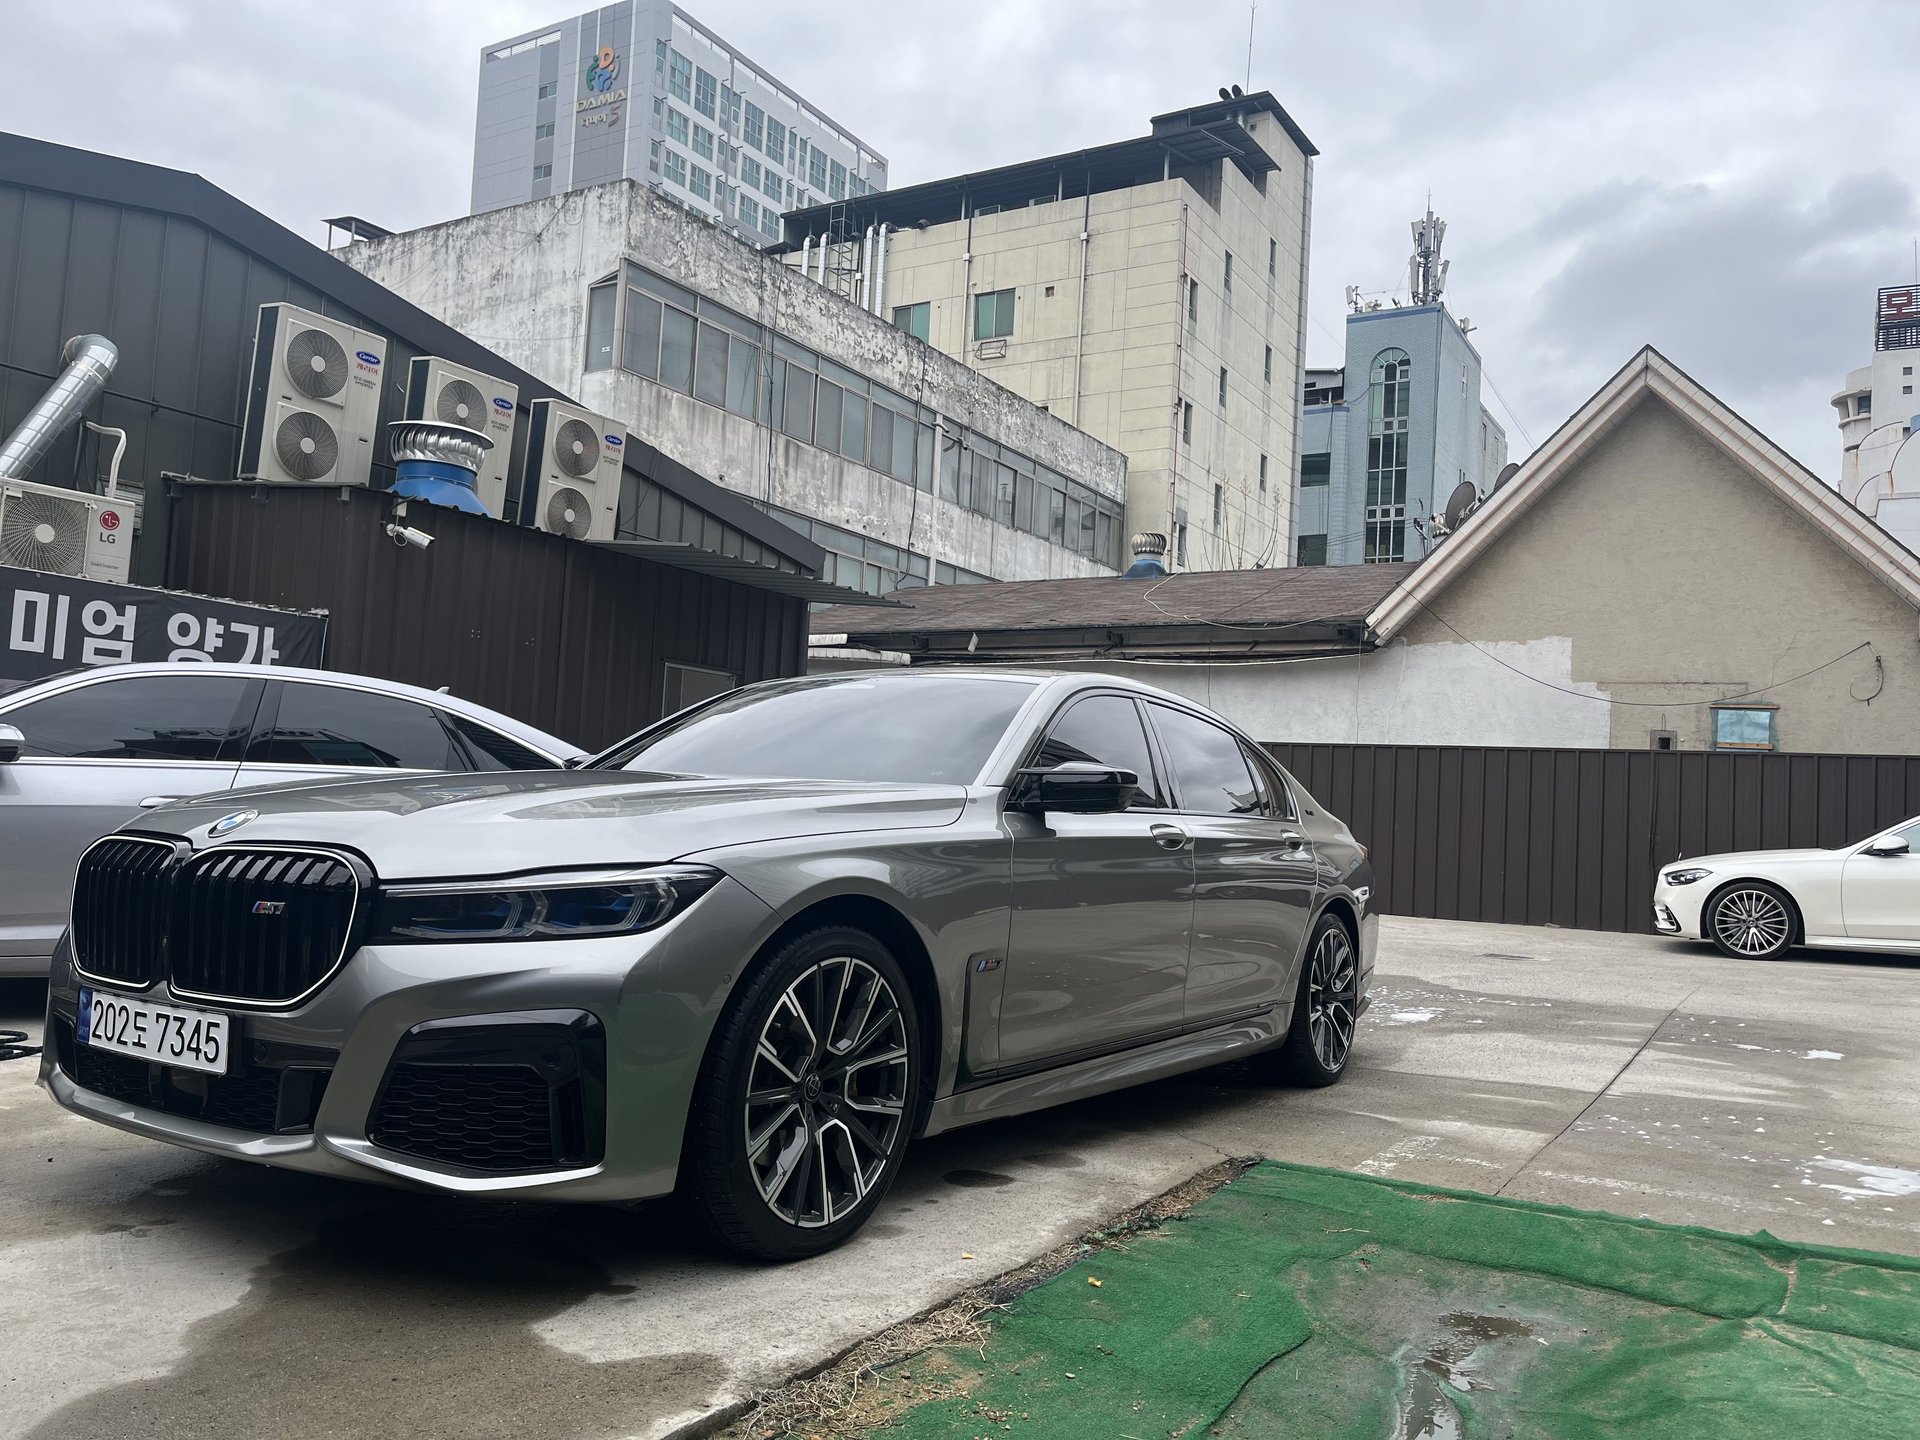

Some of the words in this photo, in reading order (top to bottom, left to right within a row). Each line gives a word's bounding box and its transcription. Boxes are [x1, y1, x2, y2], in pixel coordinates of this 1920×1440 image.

[576, 89, 627, 113] DAMIA
[1884, 292, 1915, 321] 모
[359, 352, 379, 364] Carrier
[356, 363, 379, 376] 캐리어
[495, 399, 512, 409] Carrier
[99, 532, 116, 544] LG
[9, 589, 137, 665] 미엄
[91, 999, 147, 1048] 202도
[156, 1012, 221, 1063] 7345
